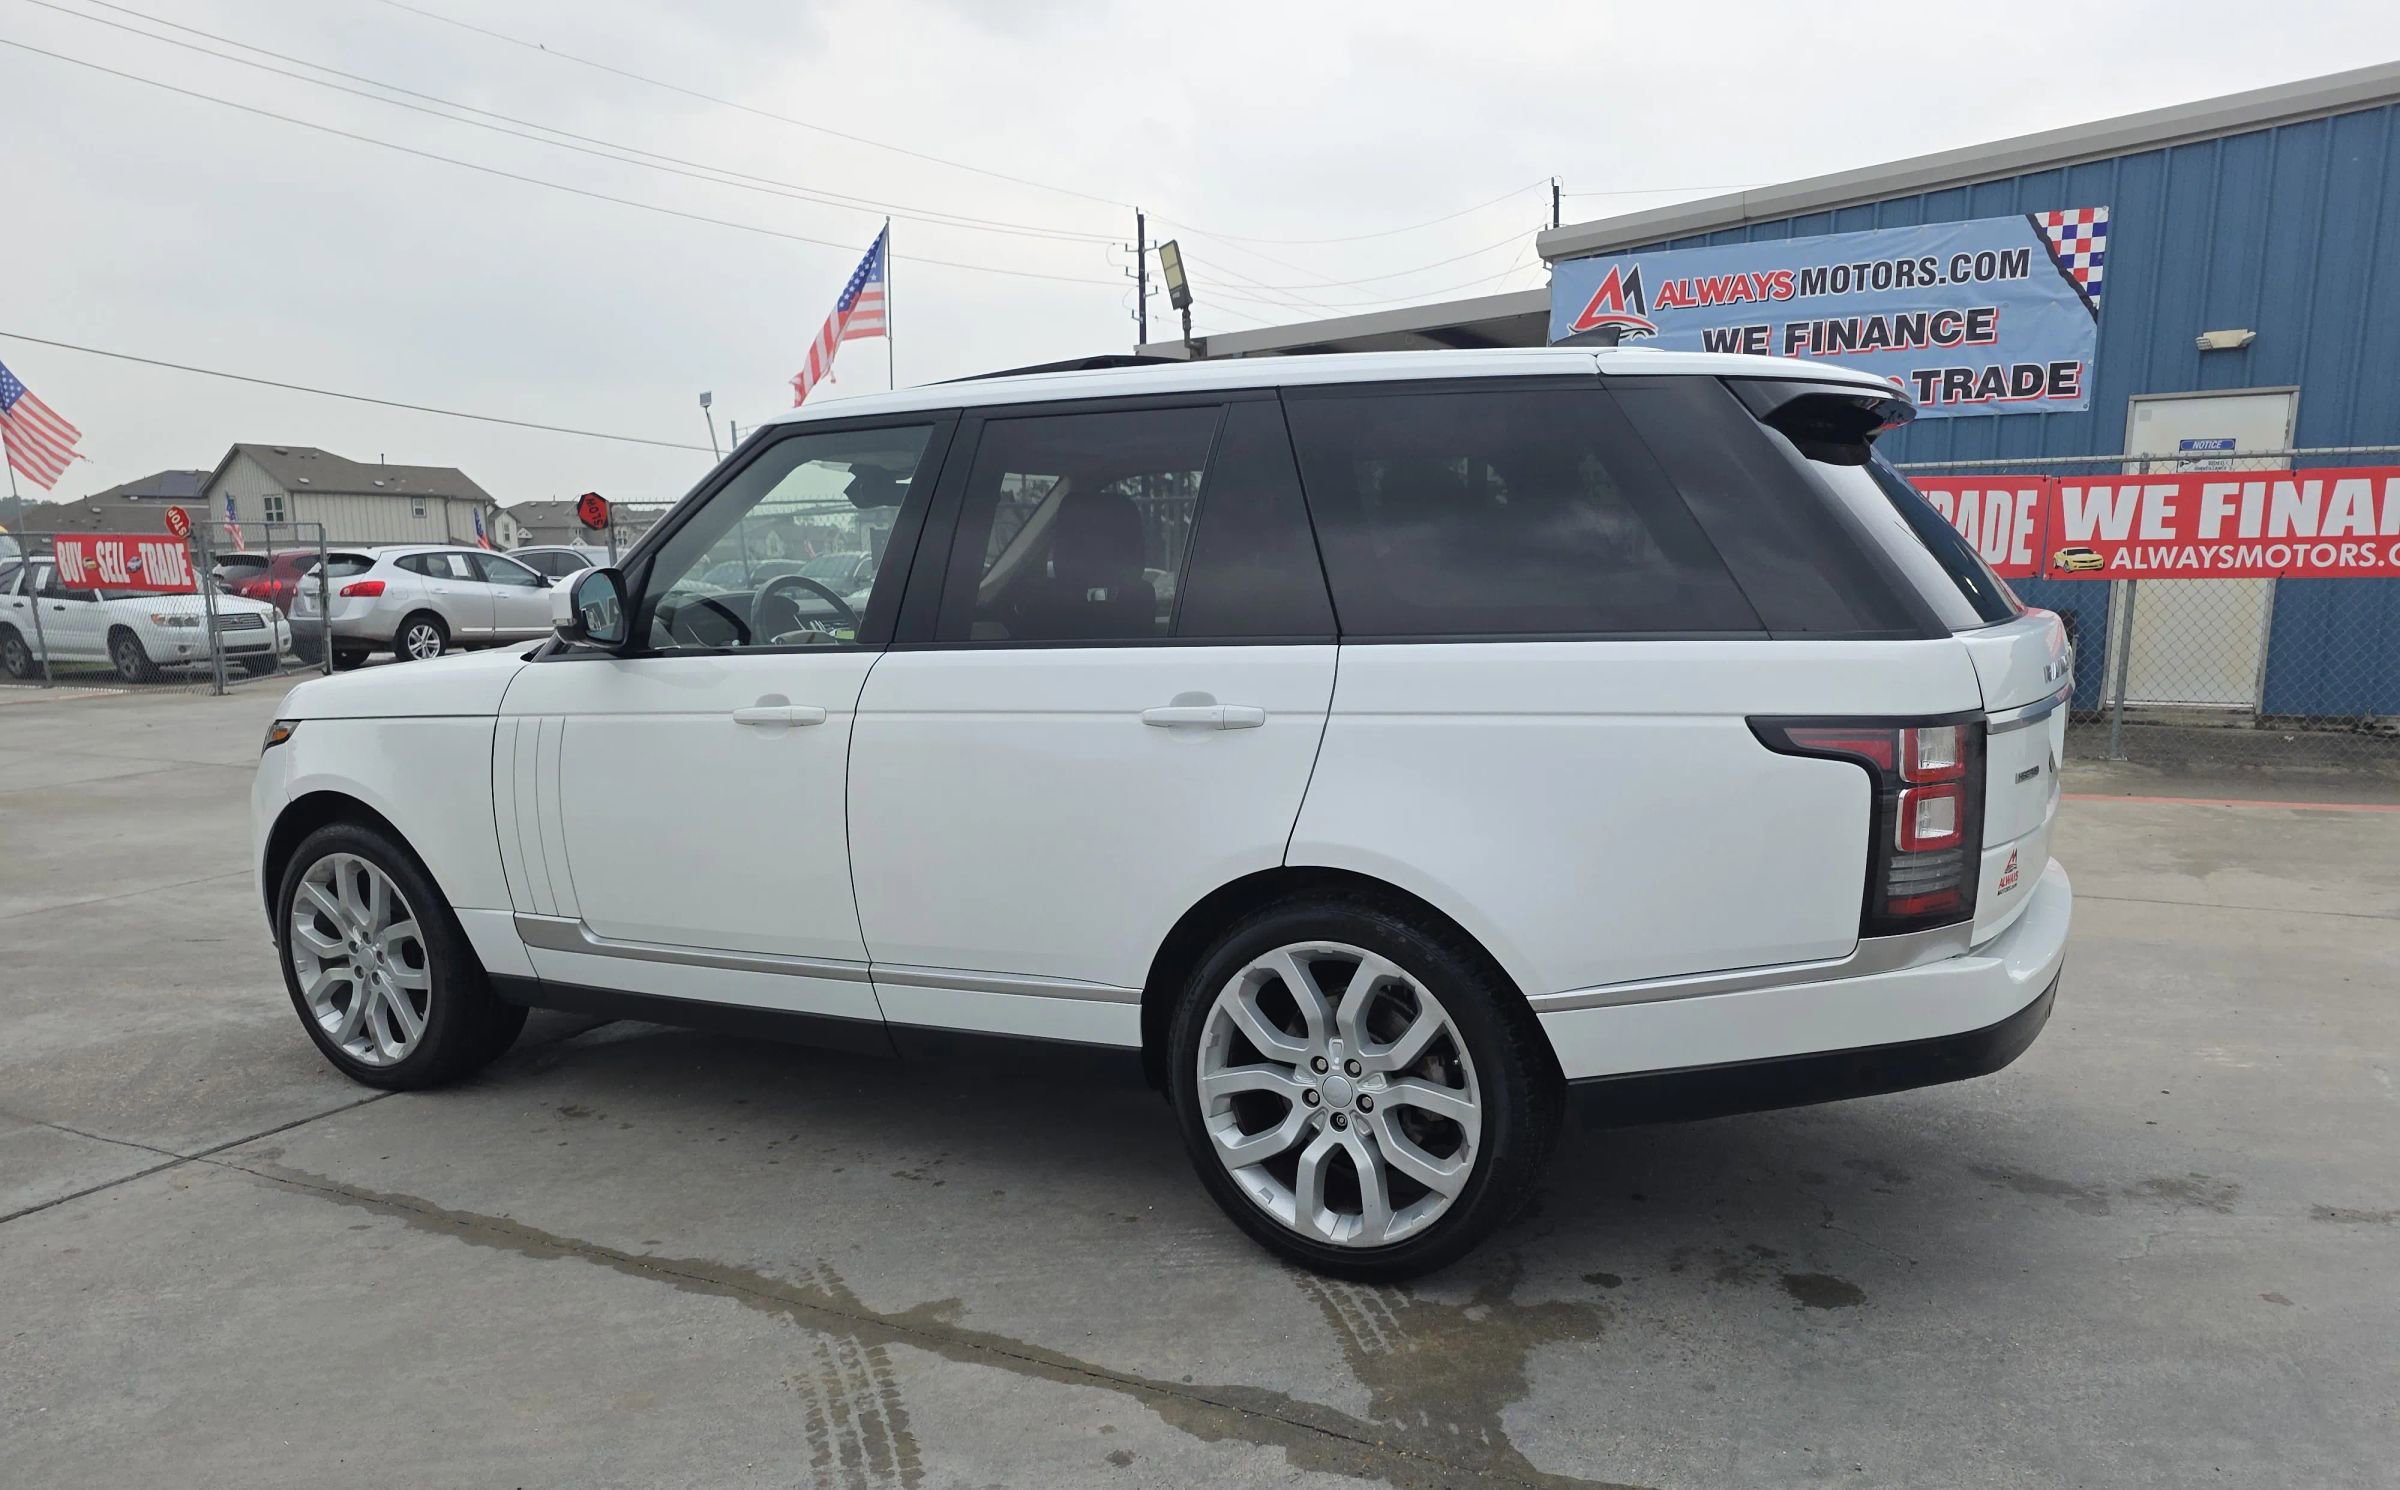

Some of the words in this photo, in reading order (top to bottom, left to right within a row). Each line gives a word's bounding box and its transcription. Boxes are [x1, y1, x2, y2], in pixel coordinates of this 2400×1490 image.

[1701, 324, 1773, 357] WE
[1782, 306, 1999, 357] FINANCE
[1910, 360, 2083, 406] TRADE
[2192, 440, 2223, 449] NOTICE
[167, 508, 188, 538] STOP
[1921, 490, 2038, 565] ADE
[2061, 484, 2180, 542] WE
[56, 541, 87, 583] BUY
[95, 540, 131, 584] SELL
[138, 543, 192, 586] TRADE
